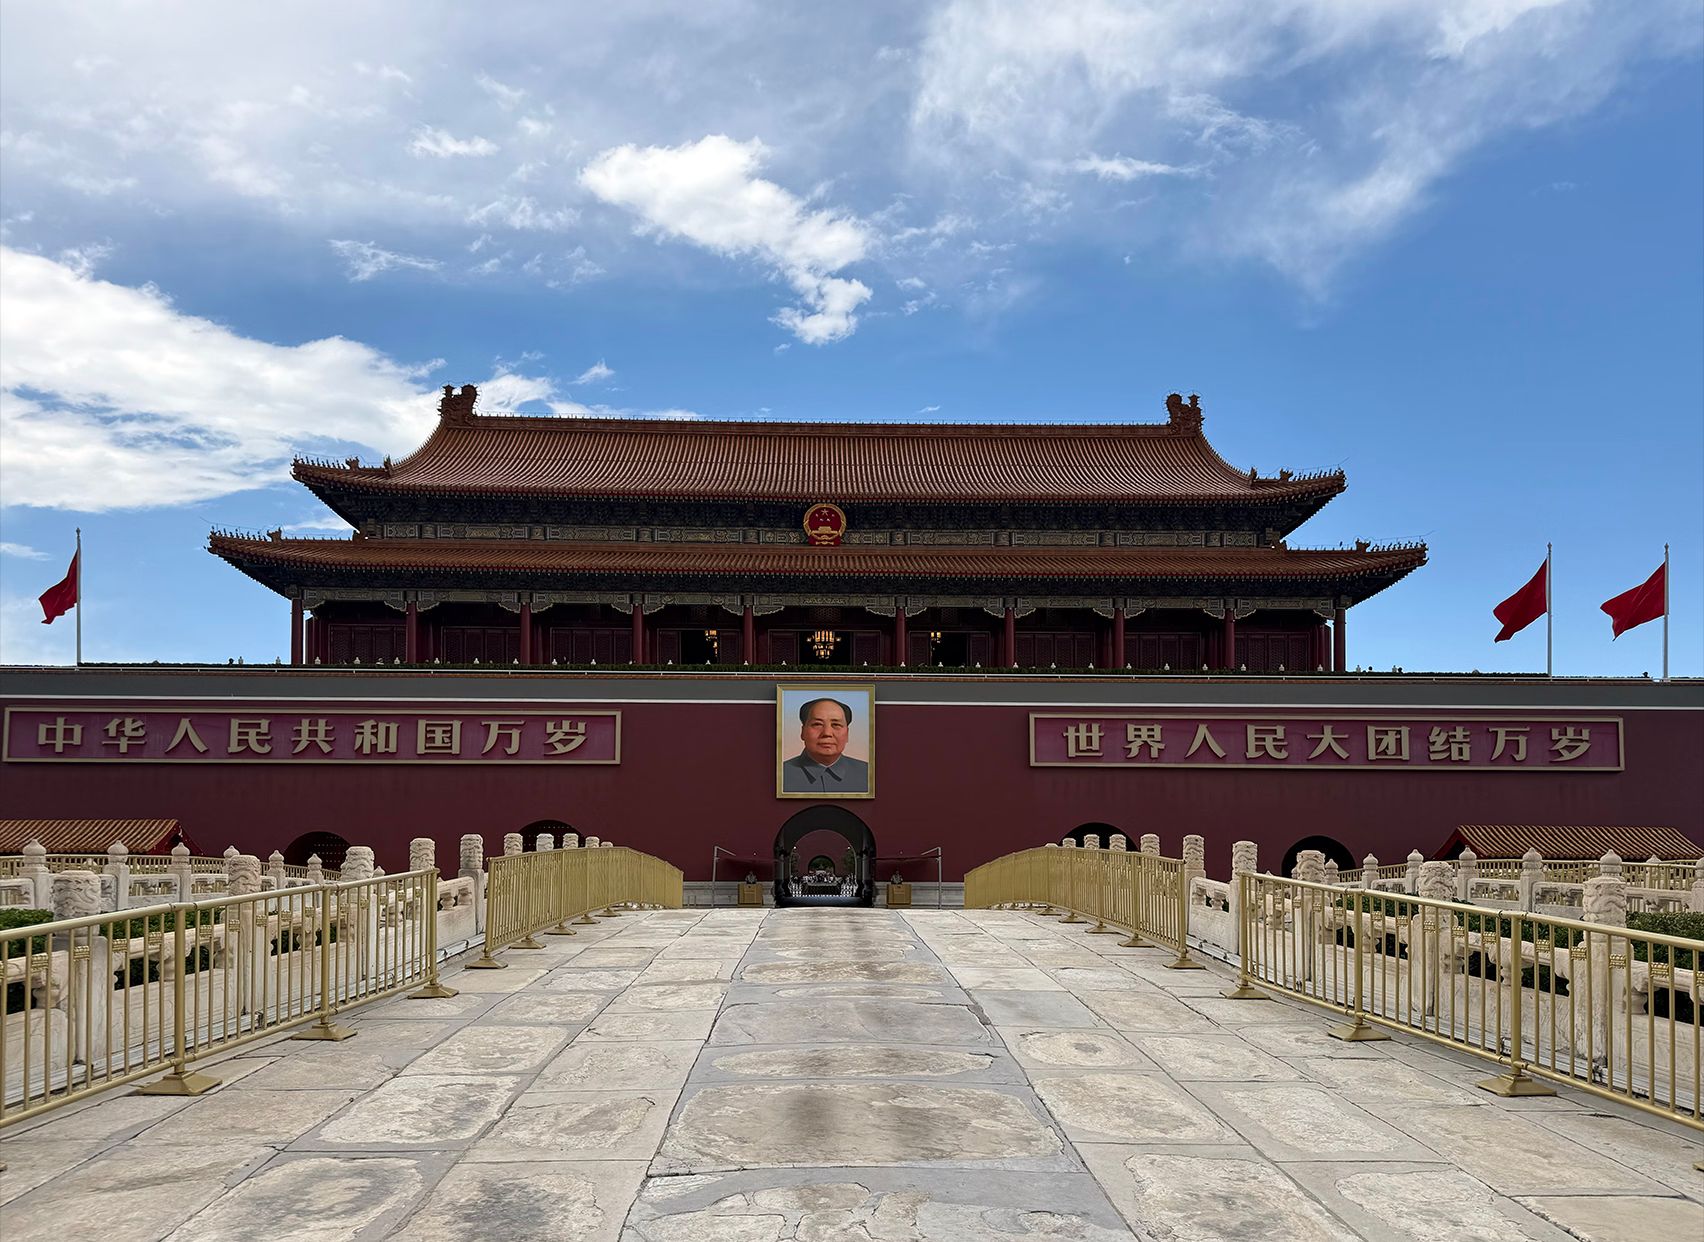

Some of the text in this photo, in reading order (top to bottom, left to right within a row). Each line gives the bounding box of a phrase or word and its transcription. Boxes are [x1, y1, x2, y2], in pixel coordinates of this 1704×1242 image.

[37, 717, 587, 755] 中华人民共和国万岁
[1062, 722, 1592, 762] 世界人民大团结万岁
